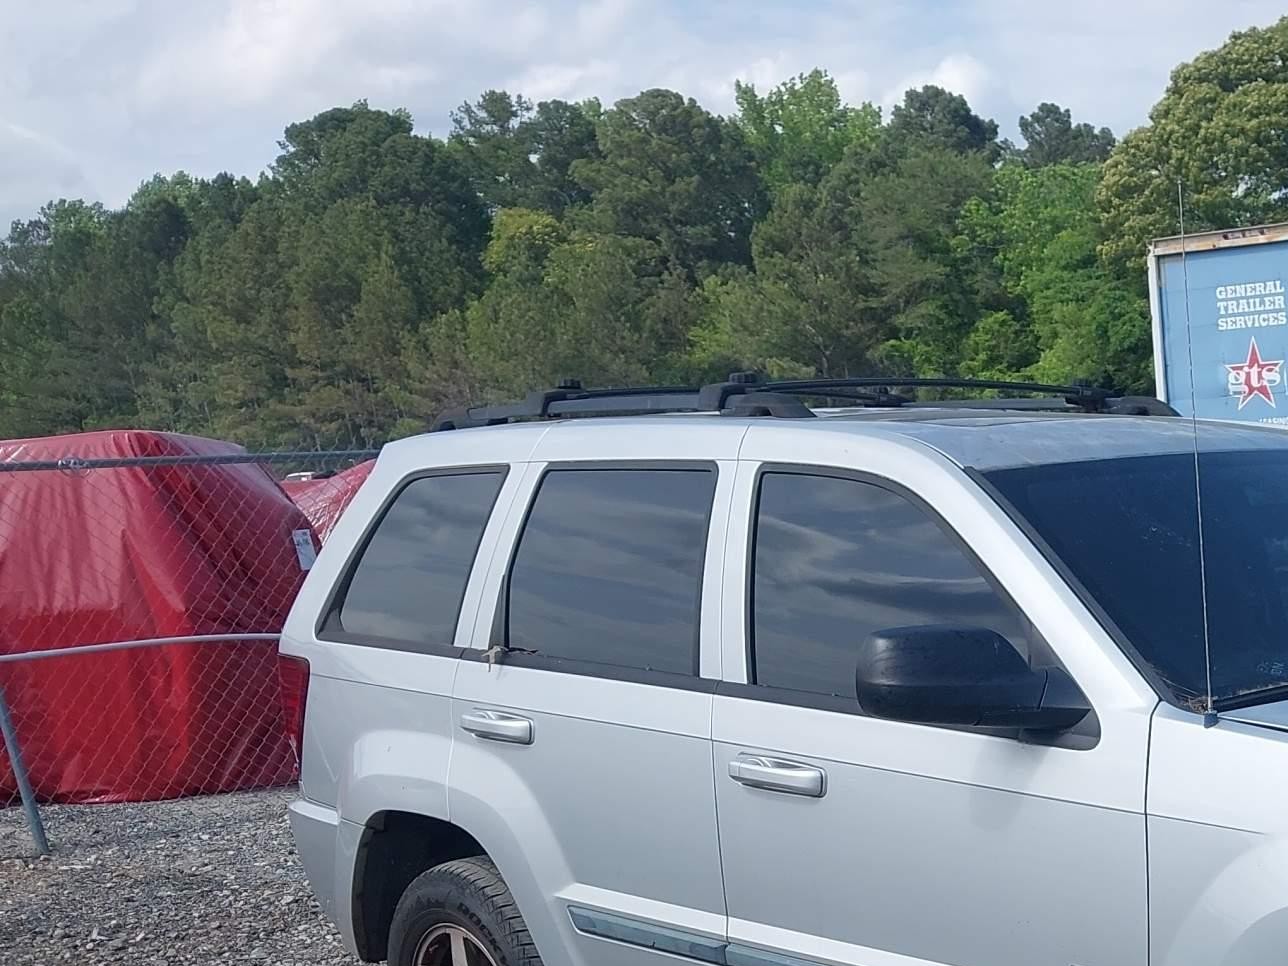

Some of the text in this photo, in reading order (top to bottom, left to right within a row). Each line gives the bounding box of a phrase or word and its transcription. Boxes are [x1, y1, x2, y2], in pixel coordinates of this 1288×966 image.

[1216, 281, 1285, 299] GENERAL
[1217, 296, 1285, 315] TRAILER
[1218, 312, 1287, 330] SERVICES
[1228, 363, 1281, 398] gts
